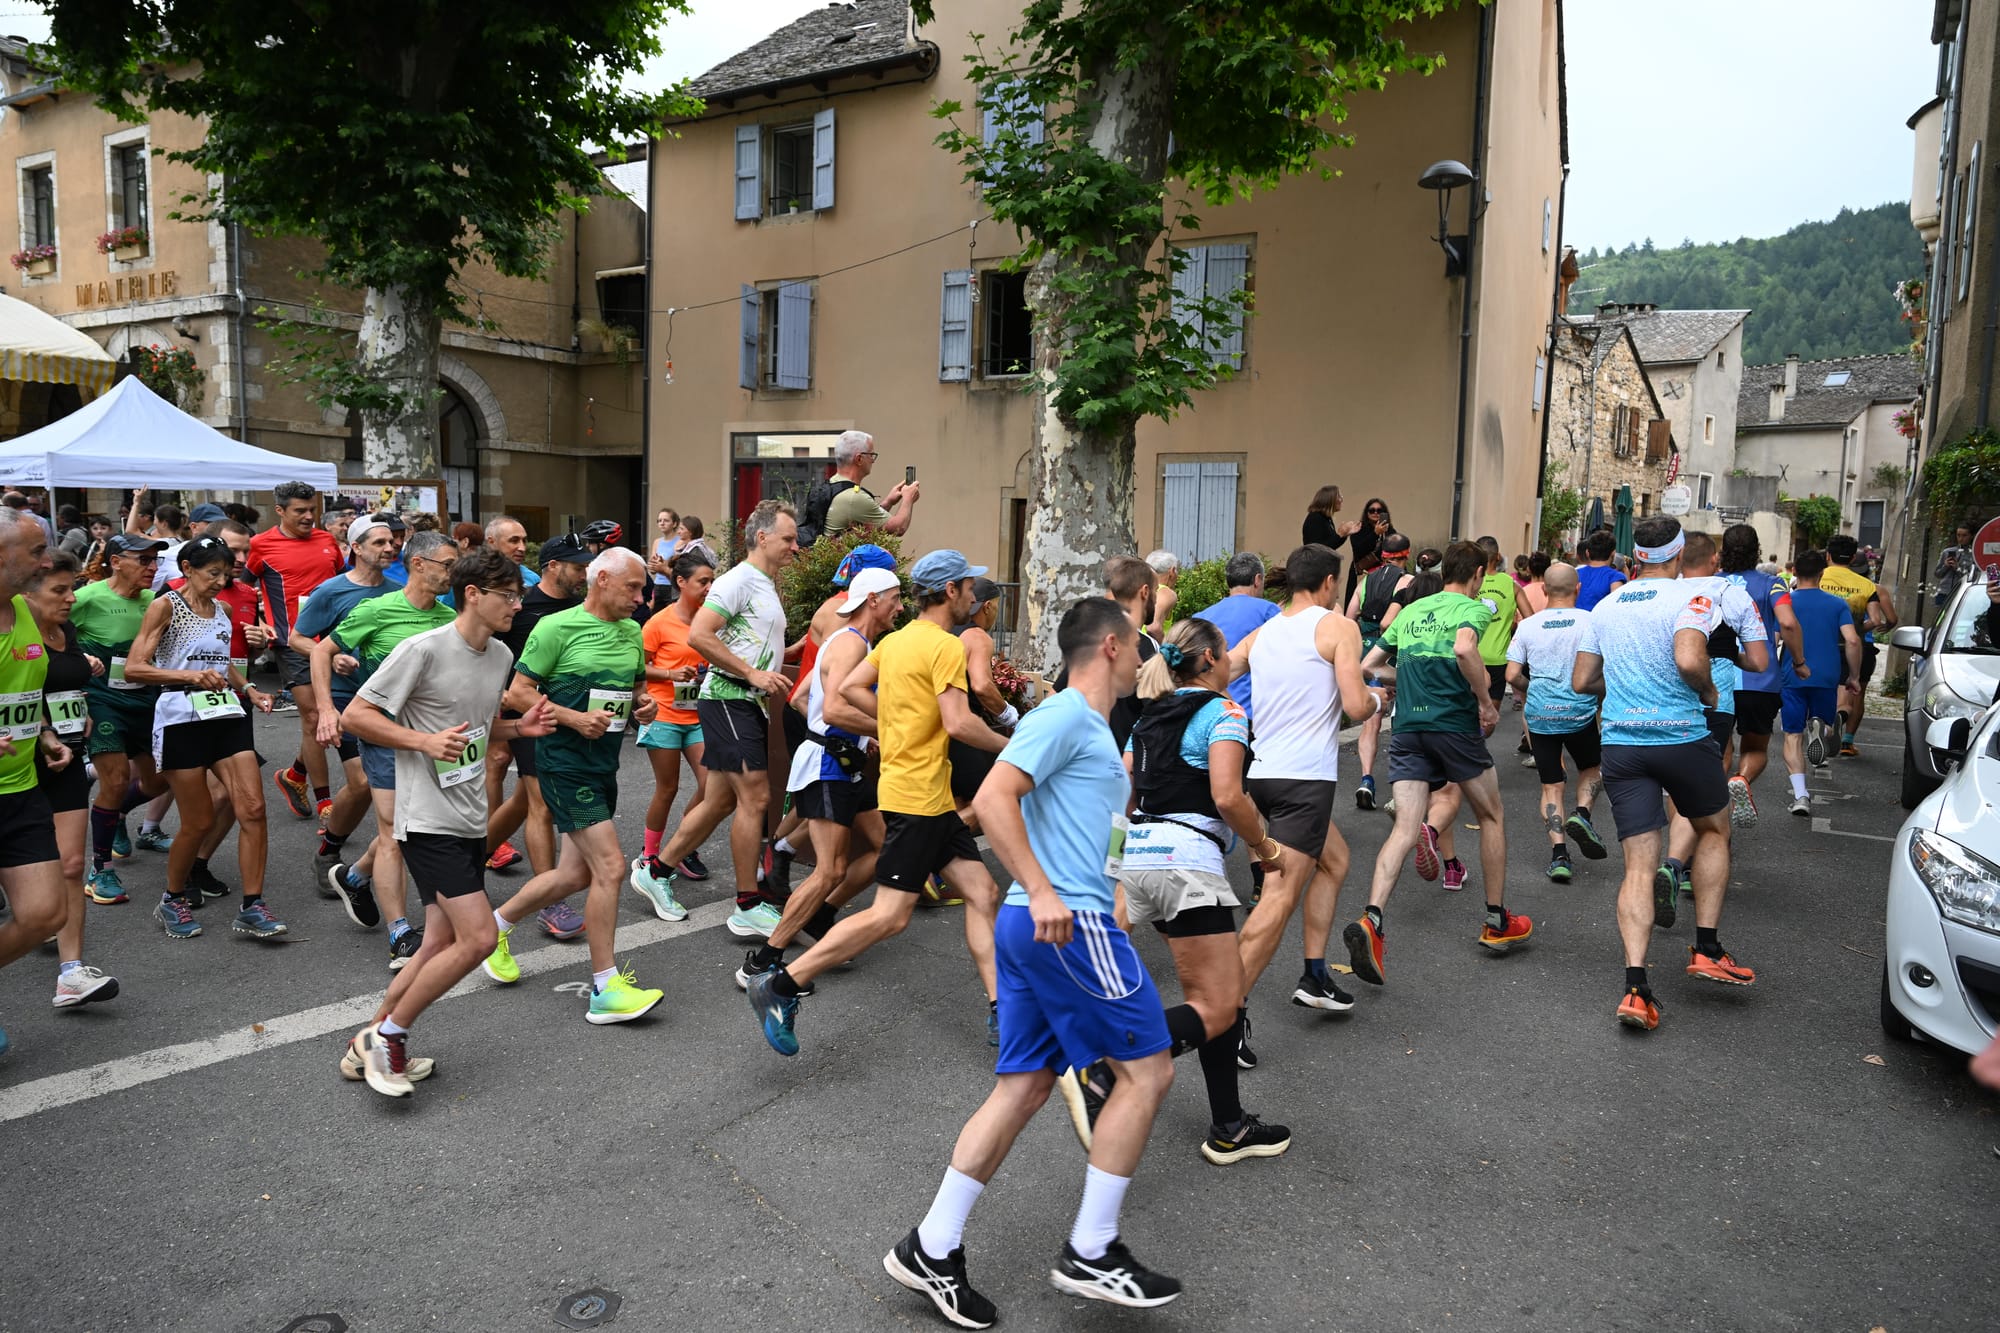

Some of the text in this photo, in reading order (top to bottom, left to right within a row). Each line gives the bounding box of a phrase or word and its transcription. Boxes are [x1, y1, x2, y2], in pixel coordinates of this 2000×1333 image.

[76, 270, 176, 307] MAIRIE
[1616, 589, 1658, 603] MARCO
[205, 692, 228, 706] 57
[681, 687, 700, 700] 10
[0, 703, 38, 725] 107
[59, 702, 87, 719] 106
[604, 701, 625, 718] 64
[1644, 719, 1691, 727] CEVENNES
